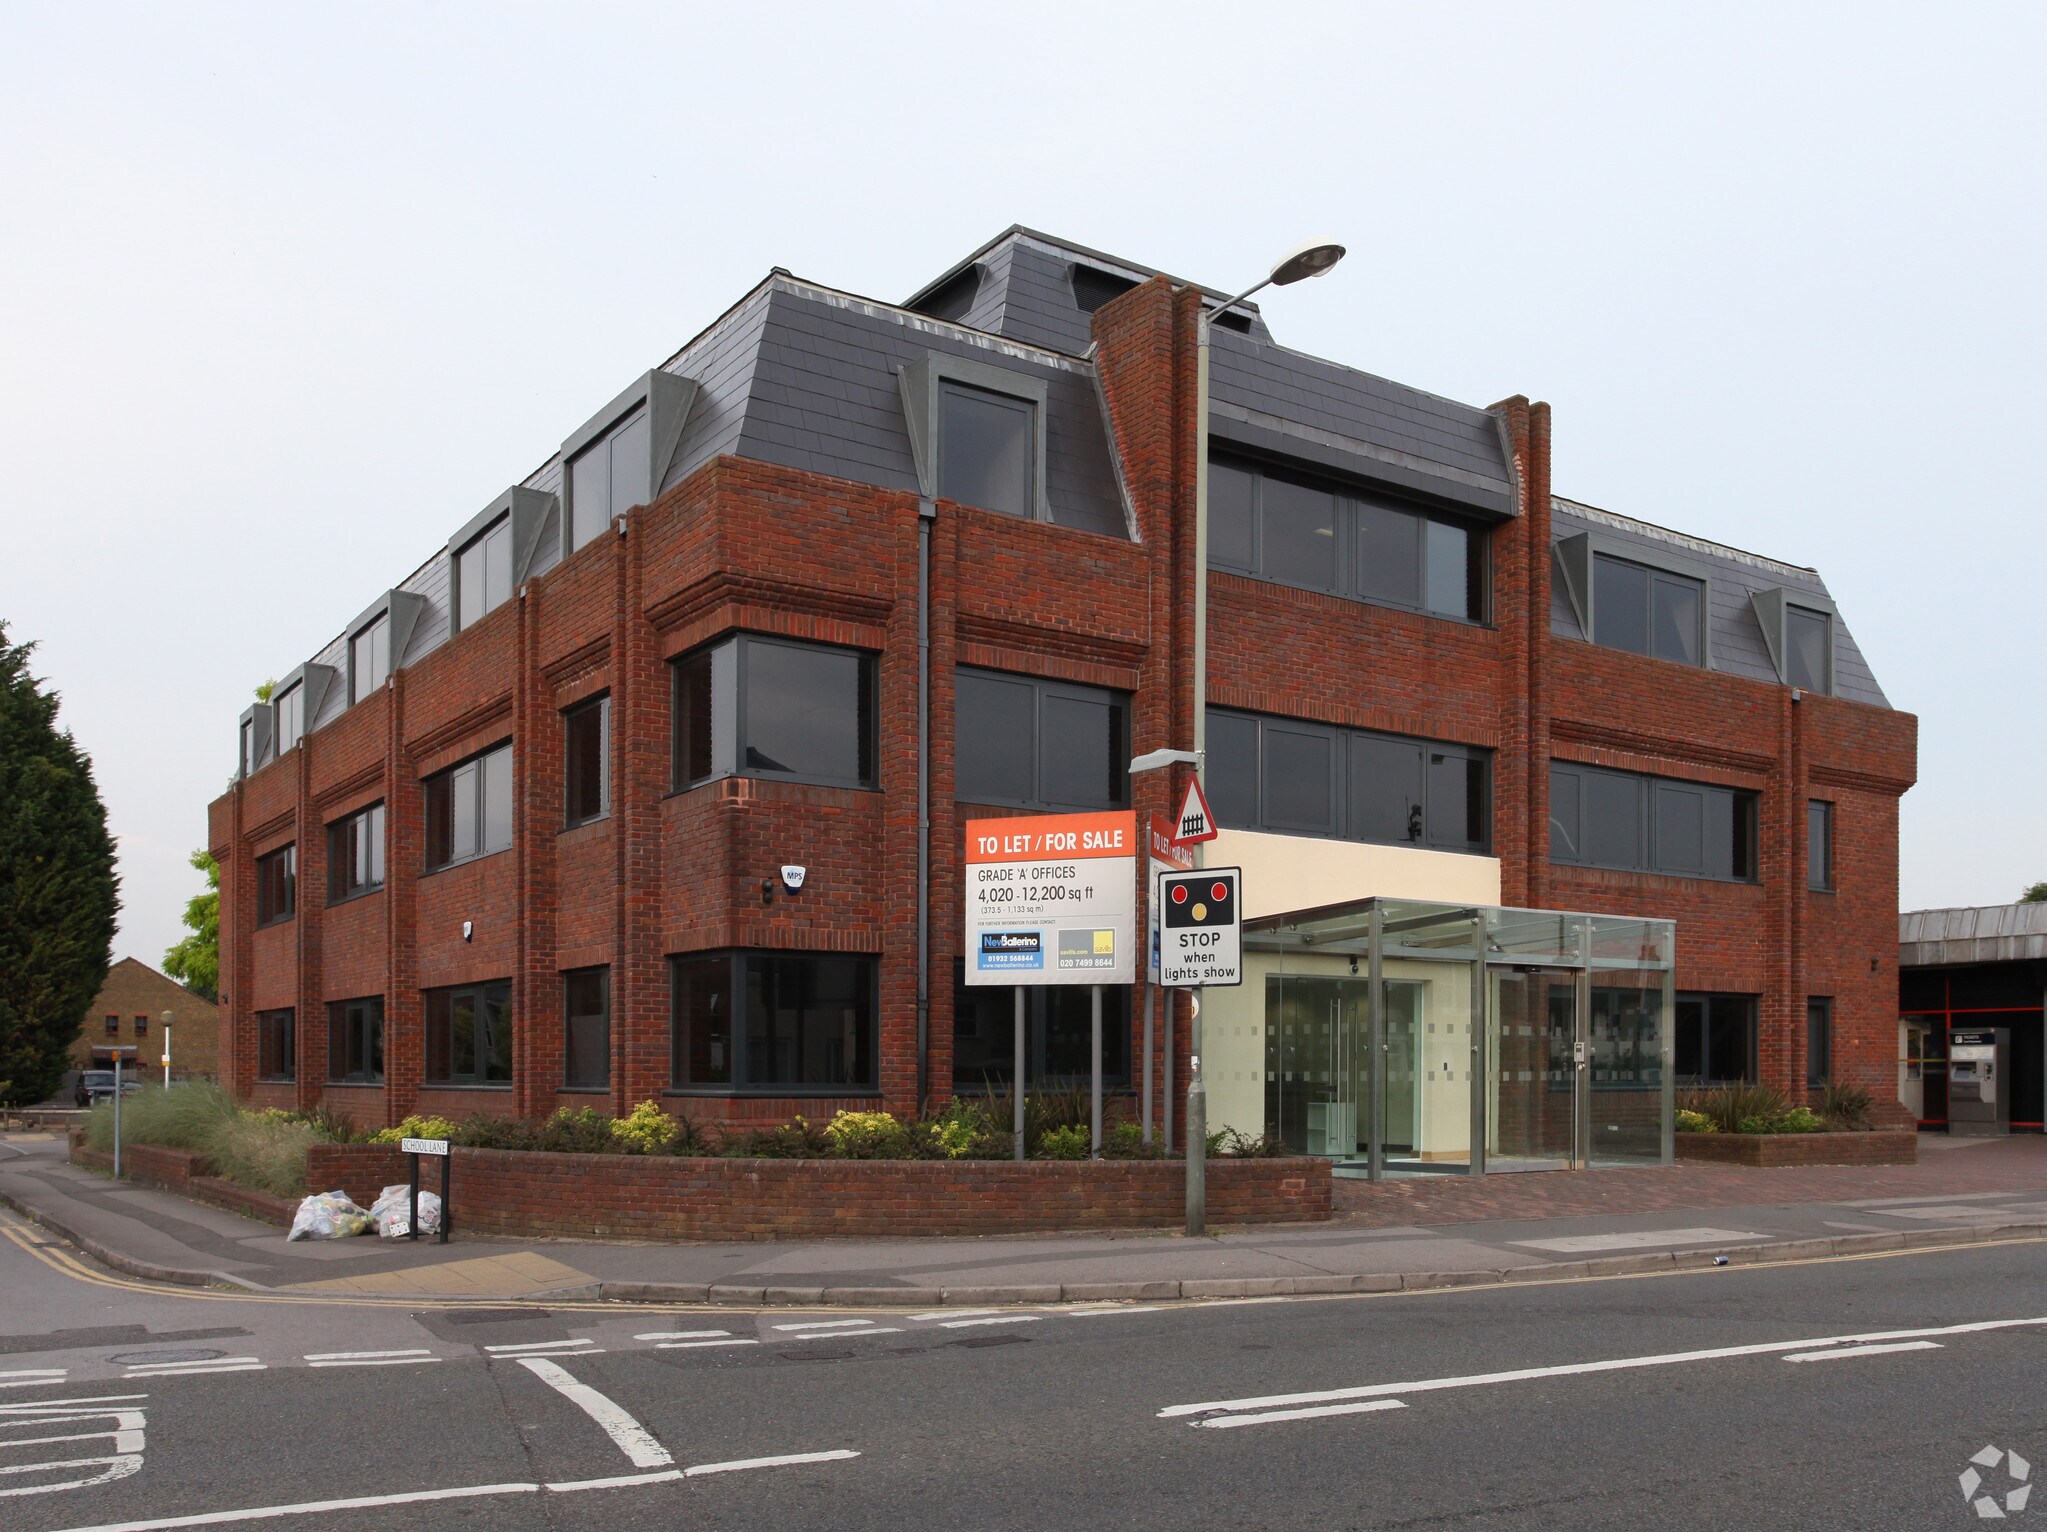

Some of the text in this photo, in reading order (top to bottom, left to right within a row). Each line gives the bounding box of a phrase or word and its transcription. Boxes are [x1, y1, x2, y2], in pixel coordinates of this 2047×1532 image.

[978, 836, 998, 854] TO
[1004, 835, 1031, 853] LET
[1045, 832, 1077, 851] FOR
[1083, 830, 1123, 849] SALE
[1154, 831, 1160, 850] TO
[1161, 836, 1169, 855] LET
[1181, 847, 1192, 867] SALE
[787, 872, 802, 880] MPS
[978, 869, 1013, 882] GRADE
[1031, 866, 1076, 880] OFFICES
[978, 887, 1014, 904] 4,020
[1022, 885, 1065, 902] 12,200
[1068, 890, 1081, 902] sq
[1085, 886, 1093, 899] ft
[981, 906, 1002, 914] (373.5
[1008, 906, 1025, 914] 1,133
[1027, 906, 1034, 914] sq
[1035, 905, 1044, 913] m)
[1179, 932, 1221, 947] STOP
[1060, 958, 1112, 967] 020 7499 8644
[1184, 951, 1215, 963] when
[1165, 966, 1235, 981] lights show
[403, 1139, 446, 1153] SCHOOL LANE
